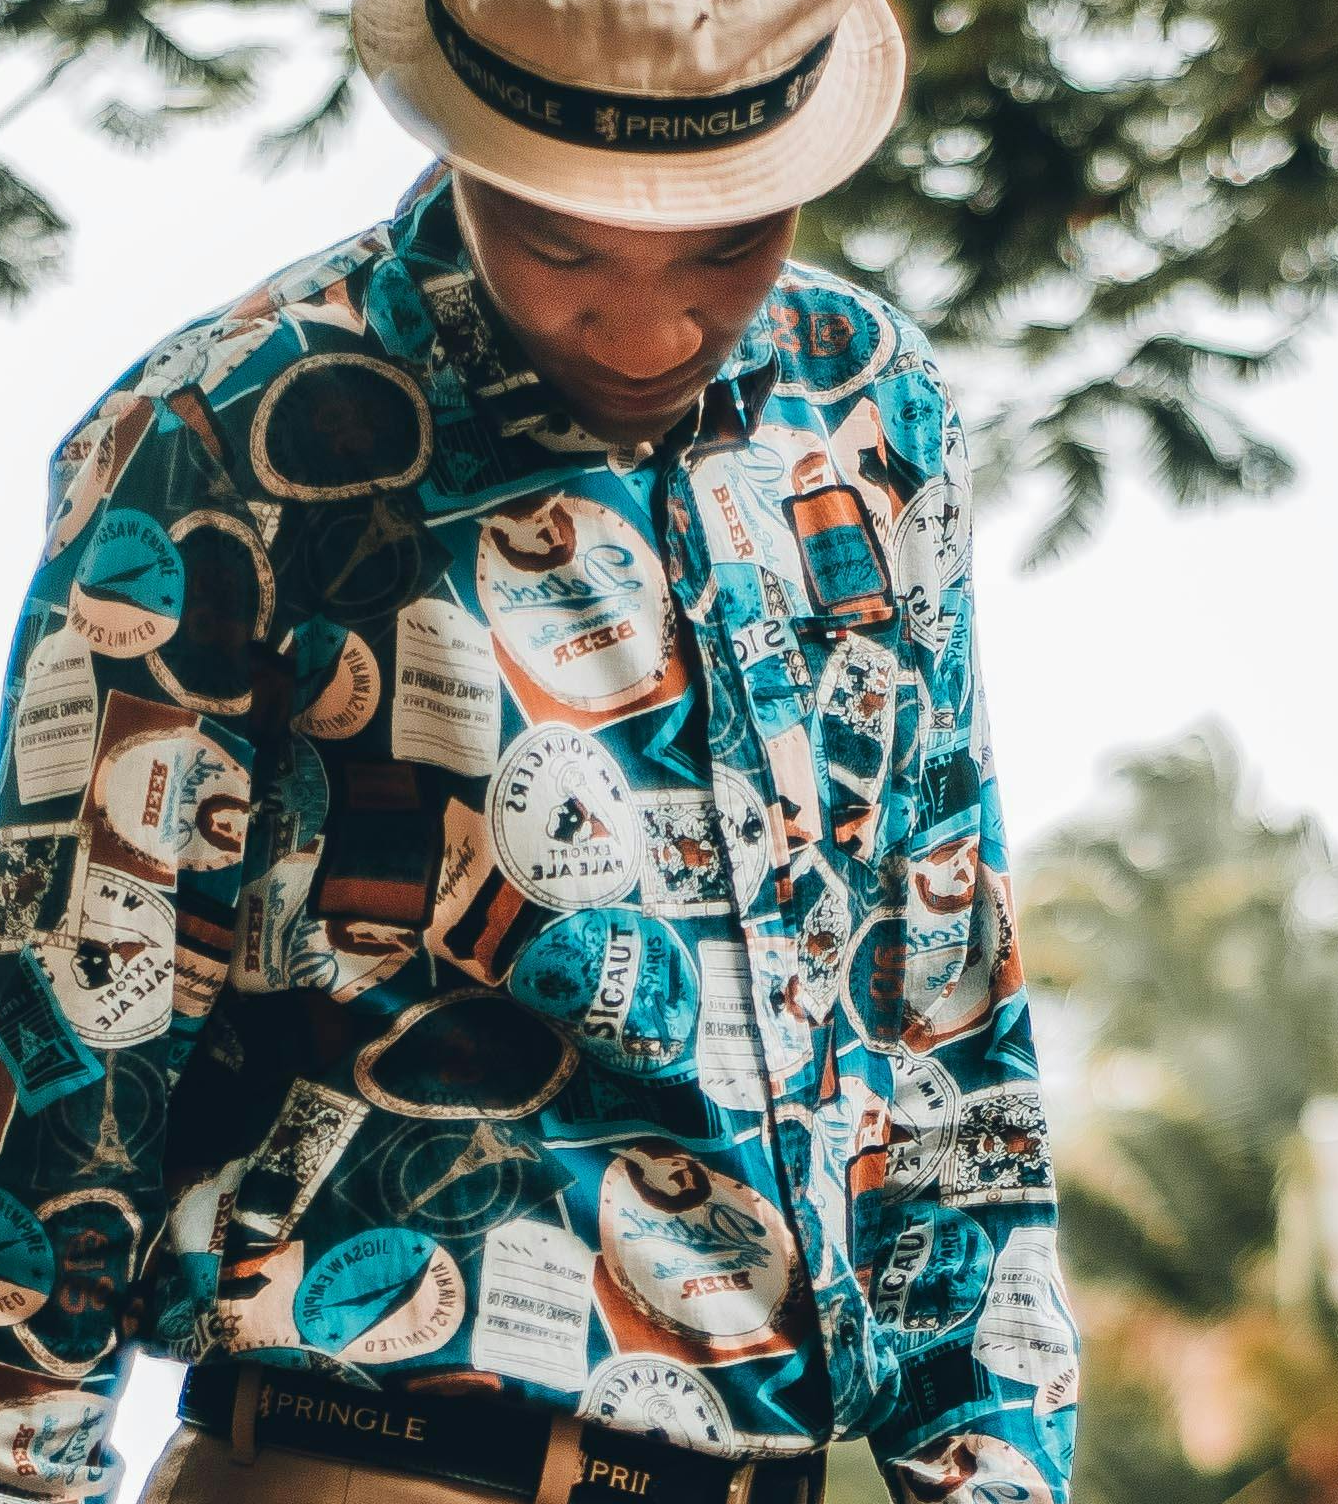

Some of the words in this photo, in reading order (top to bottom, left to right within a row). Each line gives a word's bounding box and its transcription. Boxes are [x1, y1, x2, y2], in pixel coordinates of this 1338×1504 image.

[454, 45, 563, 126] PRINGLE
[625, 99, 765, 140] PRINGLE
[712, 484, 754, 559] BEER
[107, 619, 156, 647] LIMITED
[641, 935, 662, 987] PARIS
[940, 1220, 958, 1266] PARIS
[277, 1395, 428, 1442] PRINGLE
